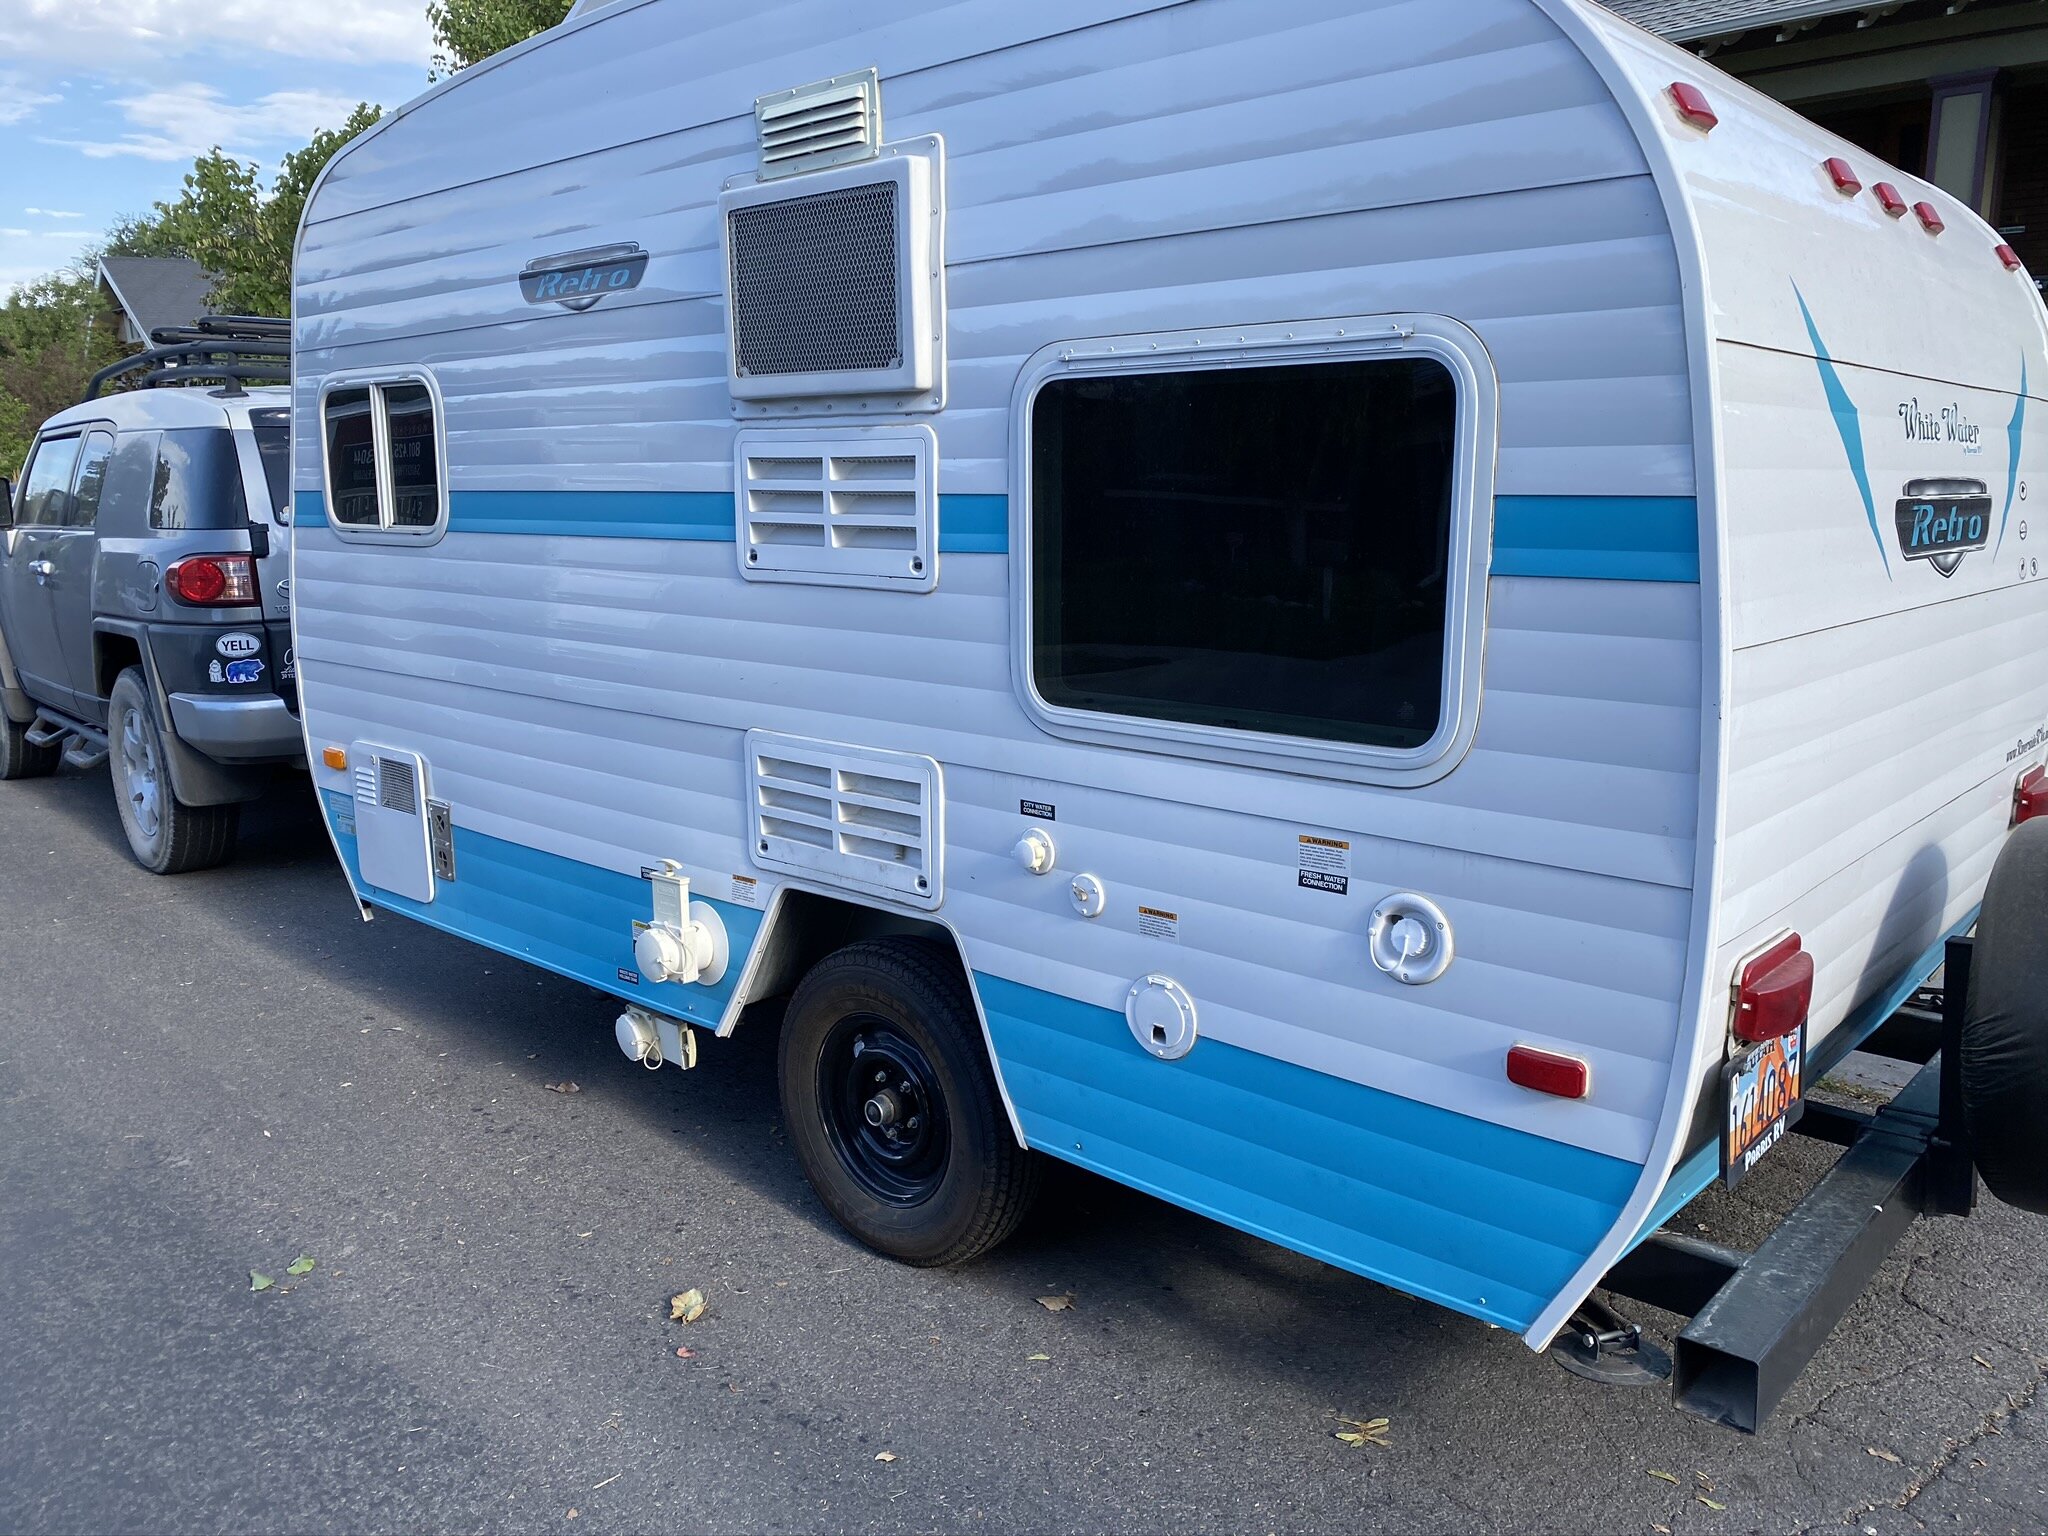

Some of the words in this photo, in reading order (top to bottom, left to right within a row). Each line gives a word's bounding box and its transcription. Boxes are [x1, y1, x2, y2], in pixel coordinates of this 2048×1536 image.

[535, 268, 630, 299] Retro
[1898, 397, 1941, 441] White
[1942, 402, 1980, 444] Water
[1910, 504, 1982, 547] Retro
[275, 605, 290, 613] TO
[221, 639, 255, 652] YELL
[1023, 807, 1053, 818] CONNECTION
[1035, 803, 1052, 812] WATER
[1312, 838, 1343, 848] WARNING
[1300, 870, 1322, 880] FRESH
[1323, 874, 1346, 885] WATER
[1302, 877, 1343, 891] CONNECTION
[1750, 1040, 1775, 1068] UTAH
[1744, 1131, 1773, 1172] PARRIS
[1773, 1115, 1786, 1142] RV
